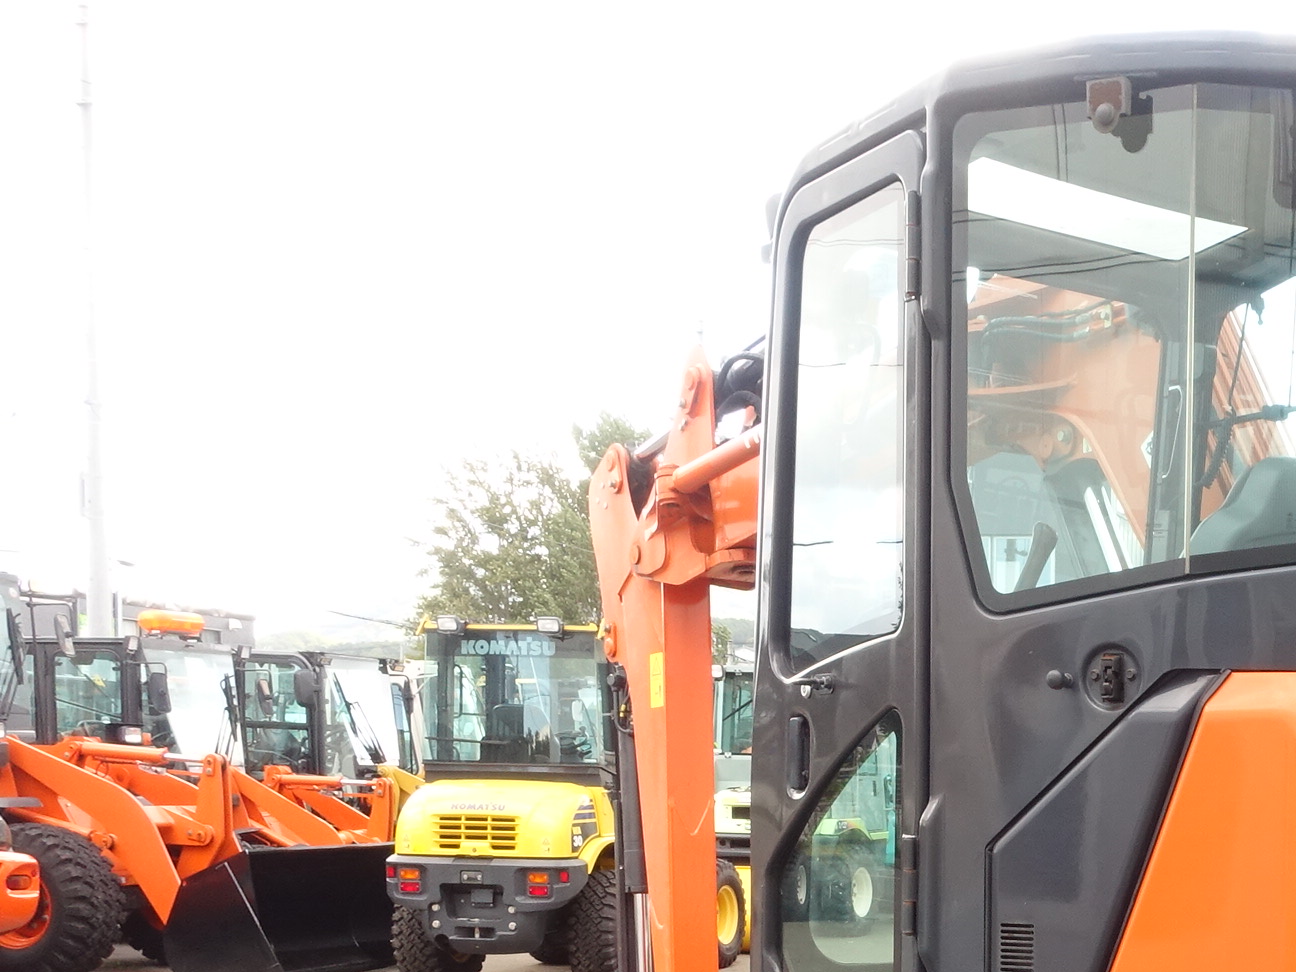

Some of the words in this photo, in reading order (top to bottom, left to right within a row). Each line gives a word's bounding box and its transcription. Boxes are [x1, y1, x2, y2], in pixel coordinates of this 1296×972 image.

[461, 637, 556, 656] KOMATSU
[450, 802, 506, 812] KOMATSU
[572, 835, 583, 847] 30
